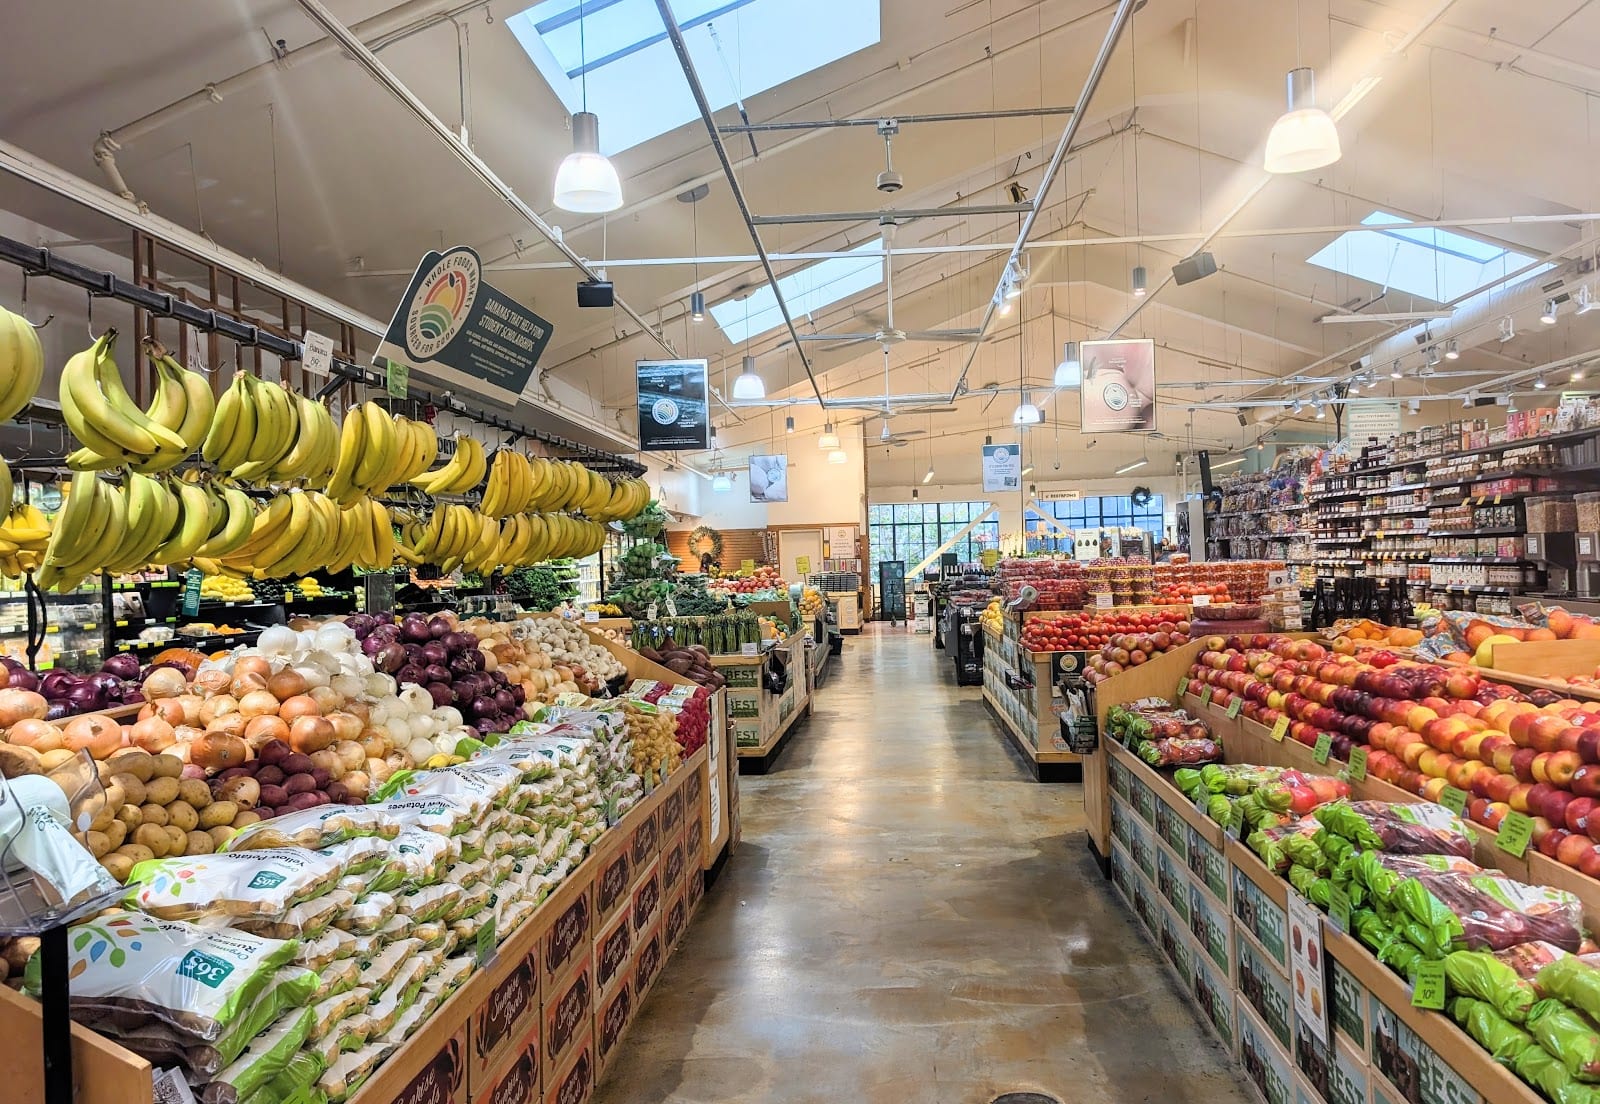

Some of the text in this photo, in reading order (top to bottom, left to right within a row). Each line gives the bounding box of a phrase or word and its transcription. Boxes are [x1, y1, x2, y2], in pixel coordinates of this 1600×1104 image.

[425, 257, 476, 308] WHOLE FOODS MARKET
[409, 309, 455, 353] SOURCED FOR GOOD
[478, 314, 504, 335] STUDENT
[500, 326, 535, 352] SCHOLARSHIPS
[484, 298, 544, 340] BANANAS THAT HELP FUND
[726, 670, 756, 680] BEST
[736, 730, 758, 740] EST
[388, 801, 426, 811] Potatoes
[427, 801, 454, 810] ellow
[271, 855, 304, 867] Yellow
[1205, 847, 1224, 881] BEST
[254, 876, 280, 889] 365
[556, 910, 576, 946] Sunrise
[1206, 914, 1227, 952] BEST
[1256, 894, 1282, 937] BEST
[207, 942, 250, 961] Organic
[208, 935, 257, 953] Russet
[184, 955, 225, 981] 365
[491, 973, 520, 1022] Sunrise
[1212, 987, 1231, 1027] BEST
[1261, 974, 1288, 1025] BEST
[1334, 966, 1361, 1015] EST
[398, 1068, 435, 1104] nrise
[1264, 1057, 1290, 1104] BEST
[1325, 1052, 1364, 1104] BEST
[1419, 1050, 1475, 1104] BES
